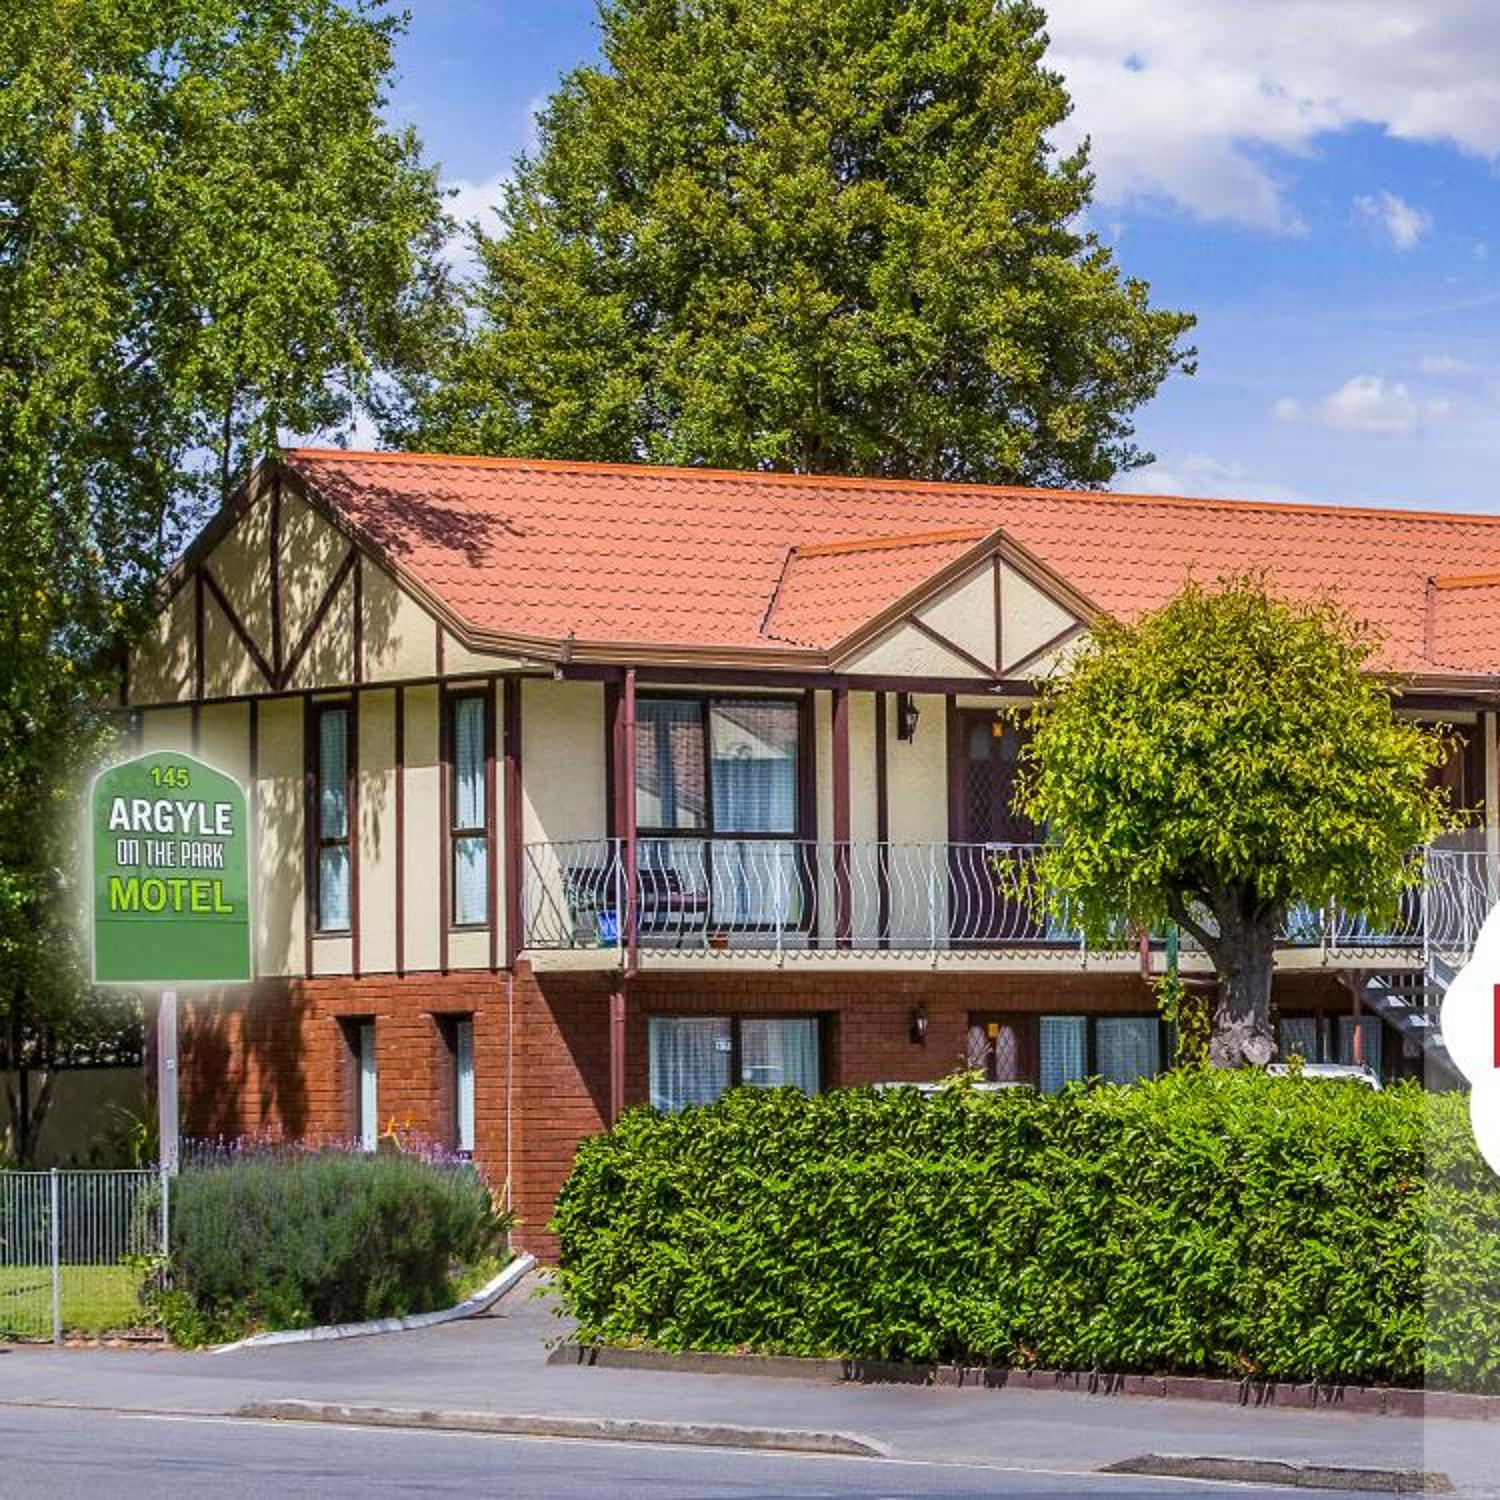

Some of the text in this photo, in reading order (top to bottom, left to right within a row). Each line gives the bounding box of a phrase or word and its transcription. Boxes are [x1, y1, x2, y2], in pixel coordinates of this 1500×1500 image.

[151, 767, 190, 788] 145
[109, 798, 233, 835] ARGYLE
[147, 839, 175, 868] THE
[181, 841, 224, 869] PARK
[109, 876, 233, 913] MOTEL
